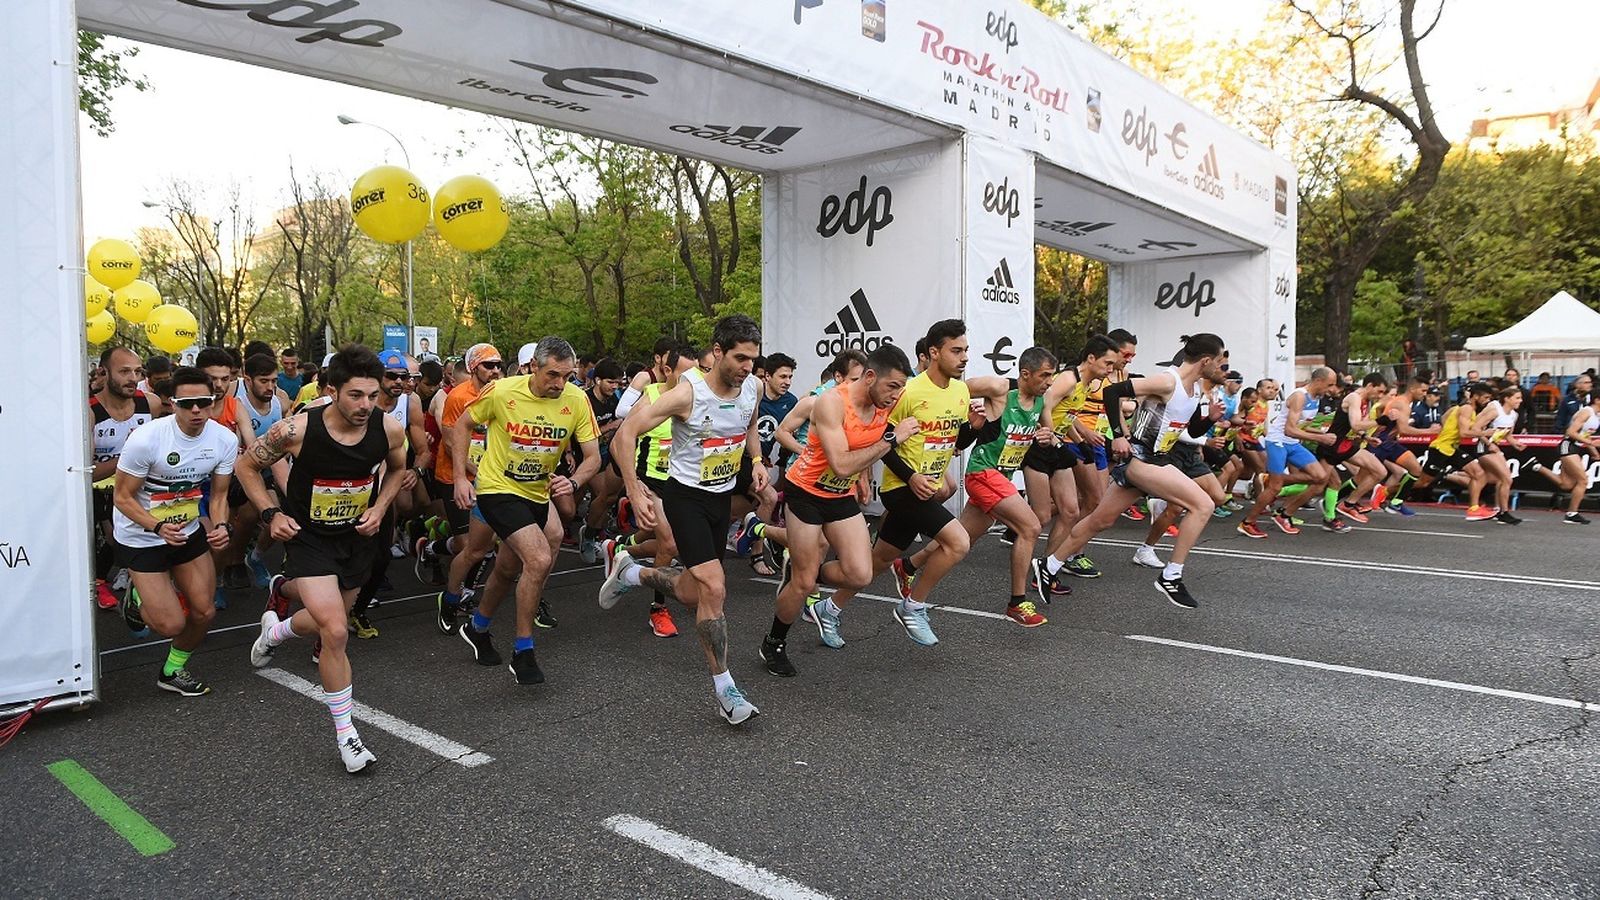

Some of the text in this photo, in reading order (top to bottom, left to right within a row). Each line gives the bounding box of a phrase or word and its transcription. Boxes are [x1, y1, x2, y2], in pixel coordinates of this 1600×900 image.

[986, 10, 1018, 54] edp
[457, 78, 591, 113] iberCaja
[943, 70, 1014, 107] MARATHON
[1023, 102, 1031, 112] &
[943, 88, 1051, 142] MADRID
[668, 124, 783, 155] adidas
[1121, 106, 1158, 167] edp
[352, 191, 384, 214] correr
[982, 176, 1020, 228] edp
[1194, 173, 1226, 201] adidas
[442, 200, 483, 221] correr
[817, 175, 894, 247] edp
[101, 260, 133, 269] correr
[982, 286, 1020, 305] adidas
[1154, 271, 1217, 318] edp
[505, 421, 568, 440] MADRID
[326, 505, 359, 519] 44277
